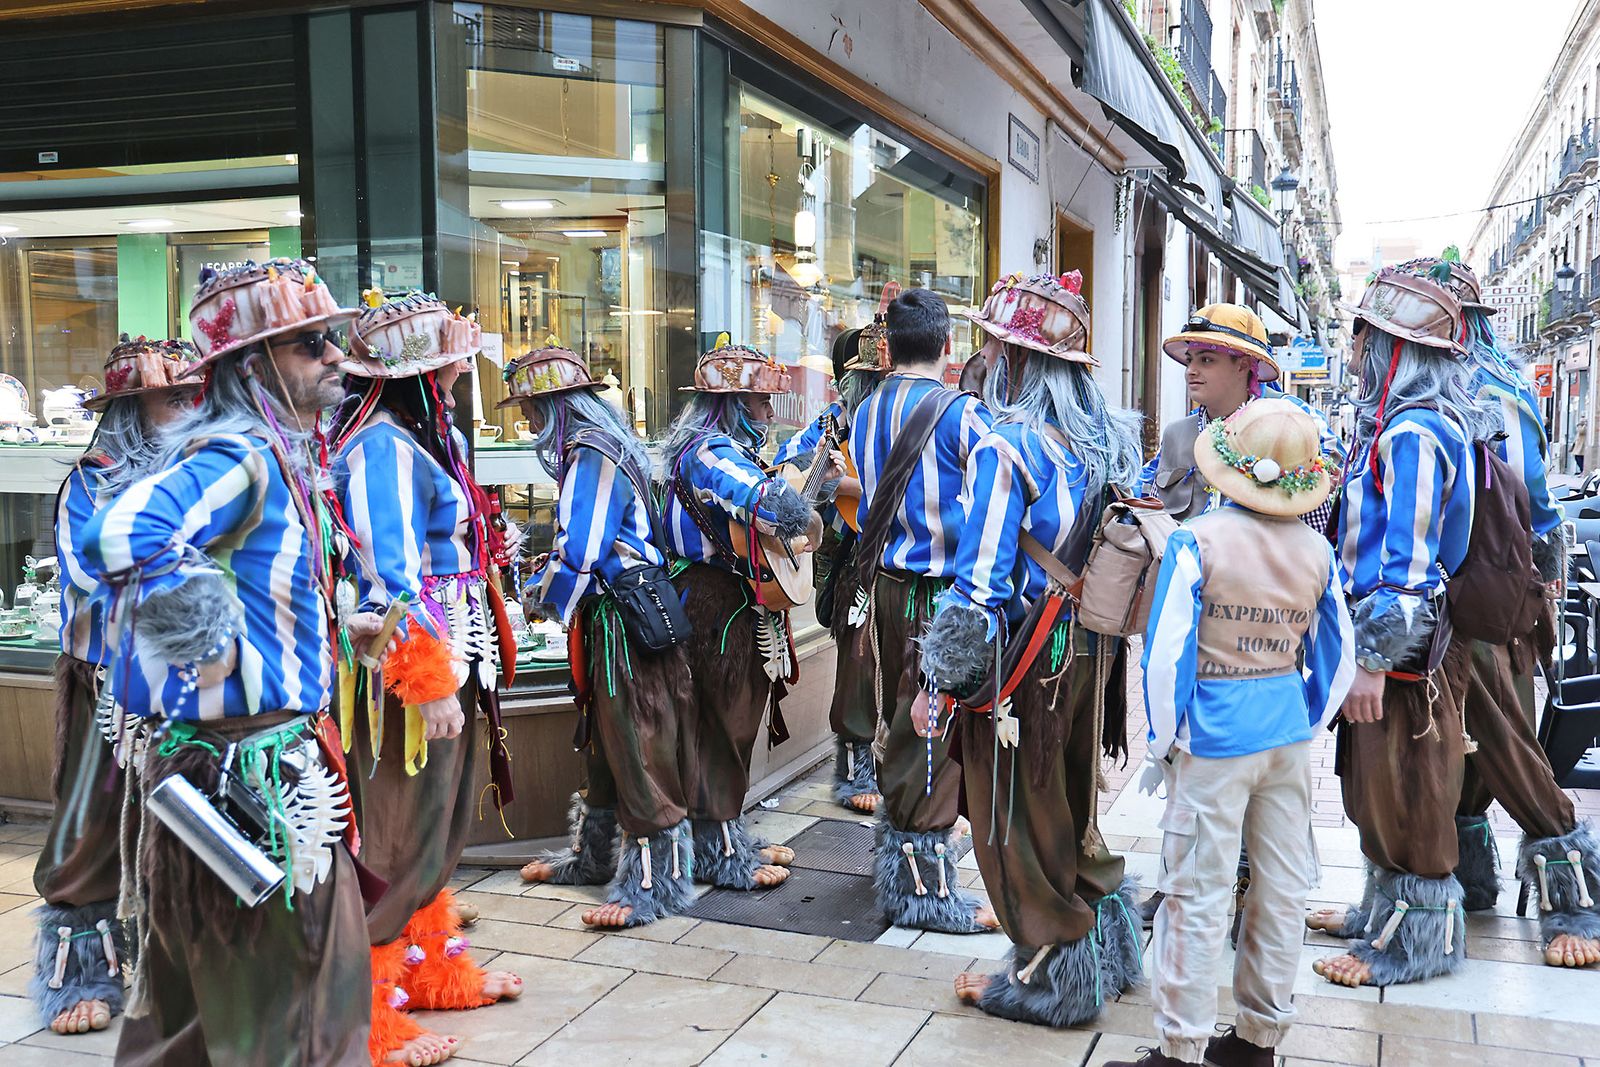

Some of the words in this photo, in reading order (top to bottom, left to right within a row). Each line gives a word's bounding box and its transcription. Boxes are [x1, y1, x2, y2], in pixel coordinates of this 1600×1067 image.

[1480, 286, 1527, 295] FOTO
[1481, 295, 1540, 304] TUDIO
[1236, 636, 1291, 654] HOMO
